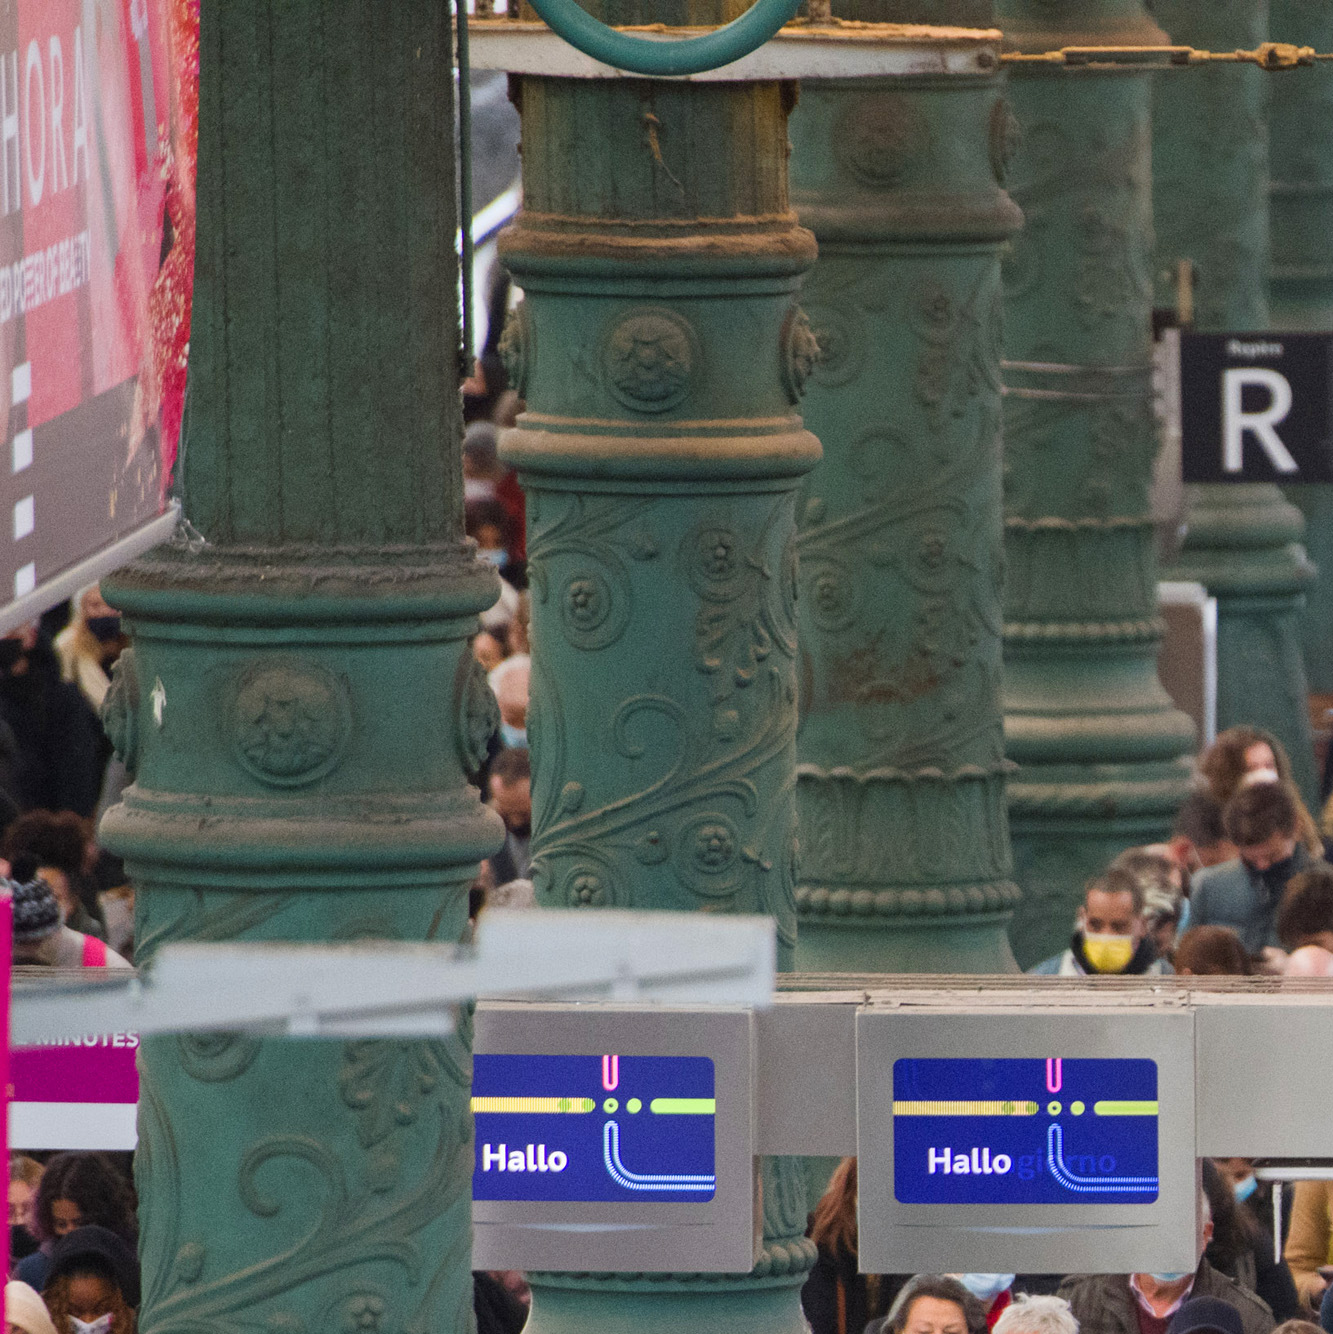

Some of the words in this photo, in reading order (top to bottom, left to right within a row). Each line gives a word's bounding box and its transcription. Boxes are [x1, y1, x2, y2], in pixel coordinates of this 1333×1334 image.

[1223, 367, 1299, 473] R
[482, 1143, 568, 1172] Hallo
[928, 1147, 1012, 1174] Hallo
